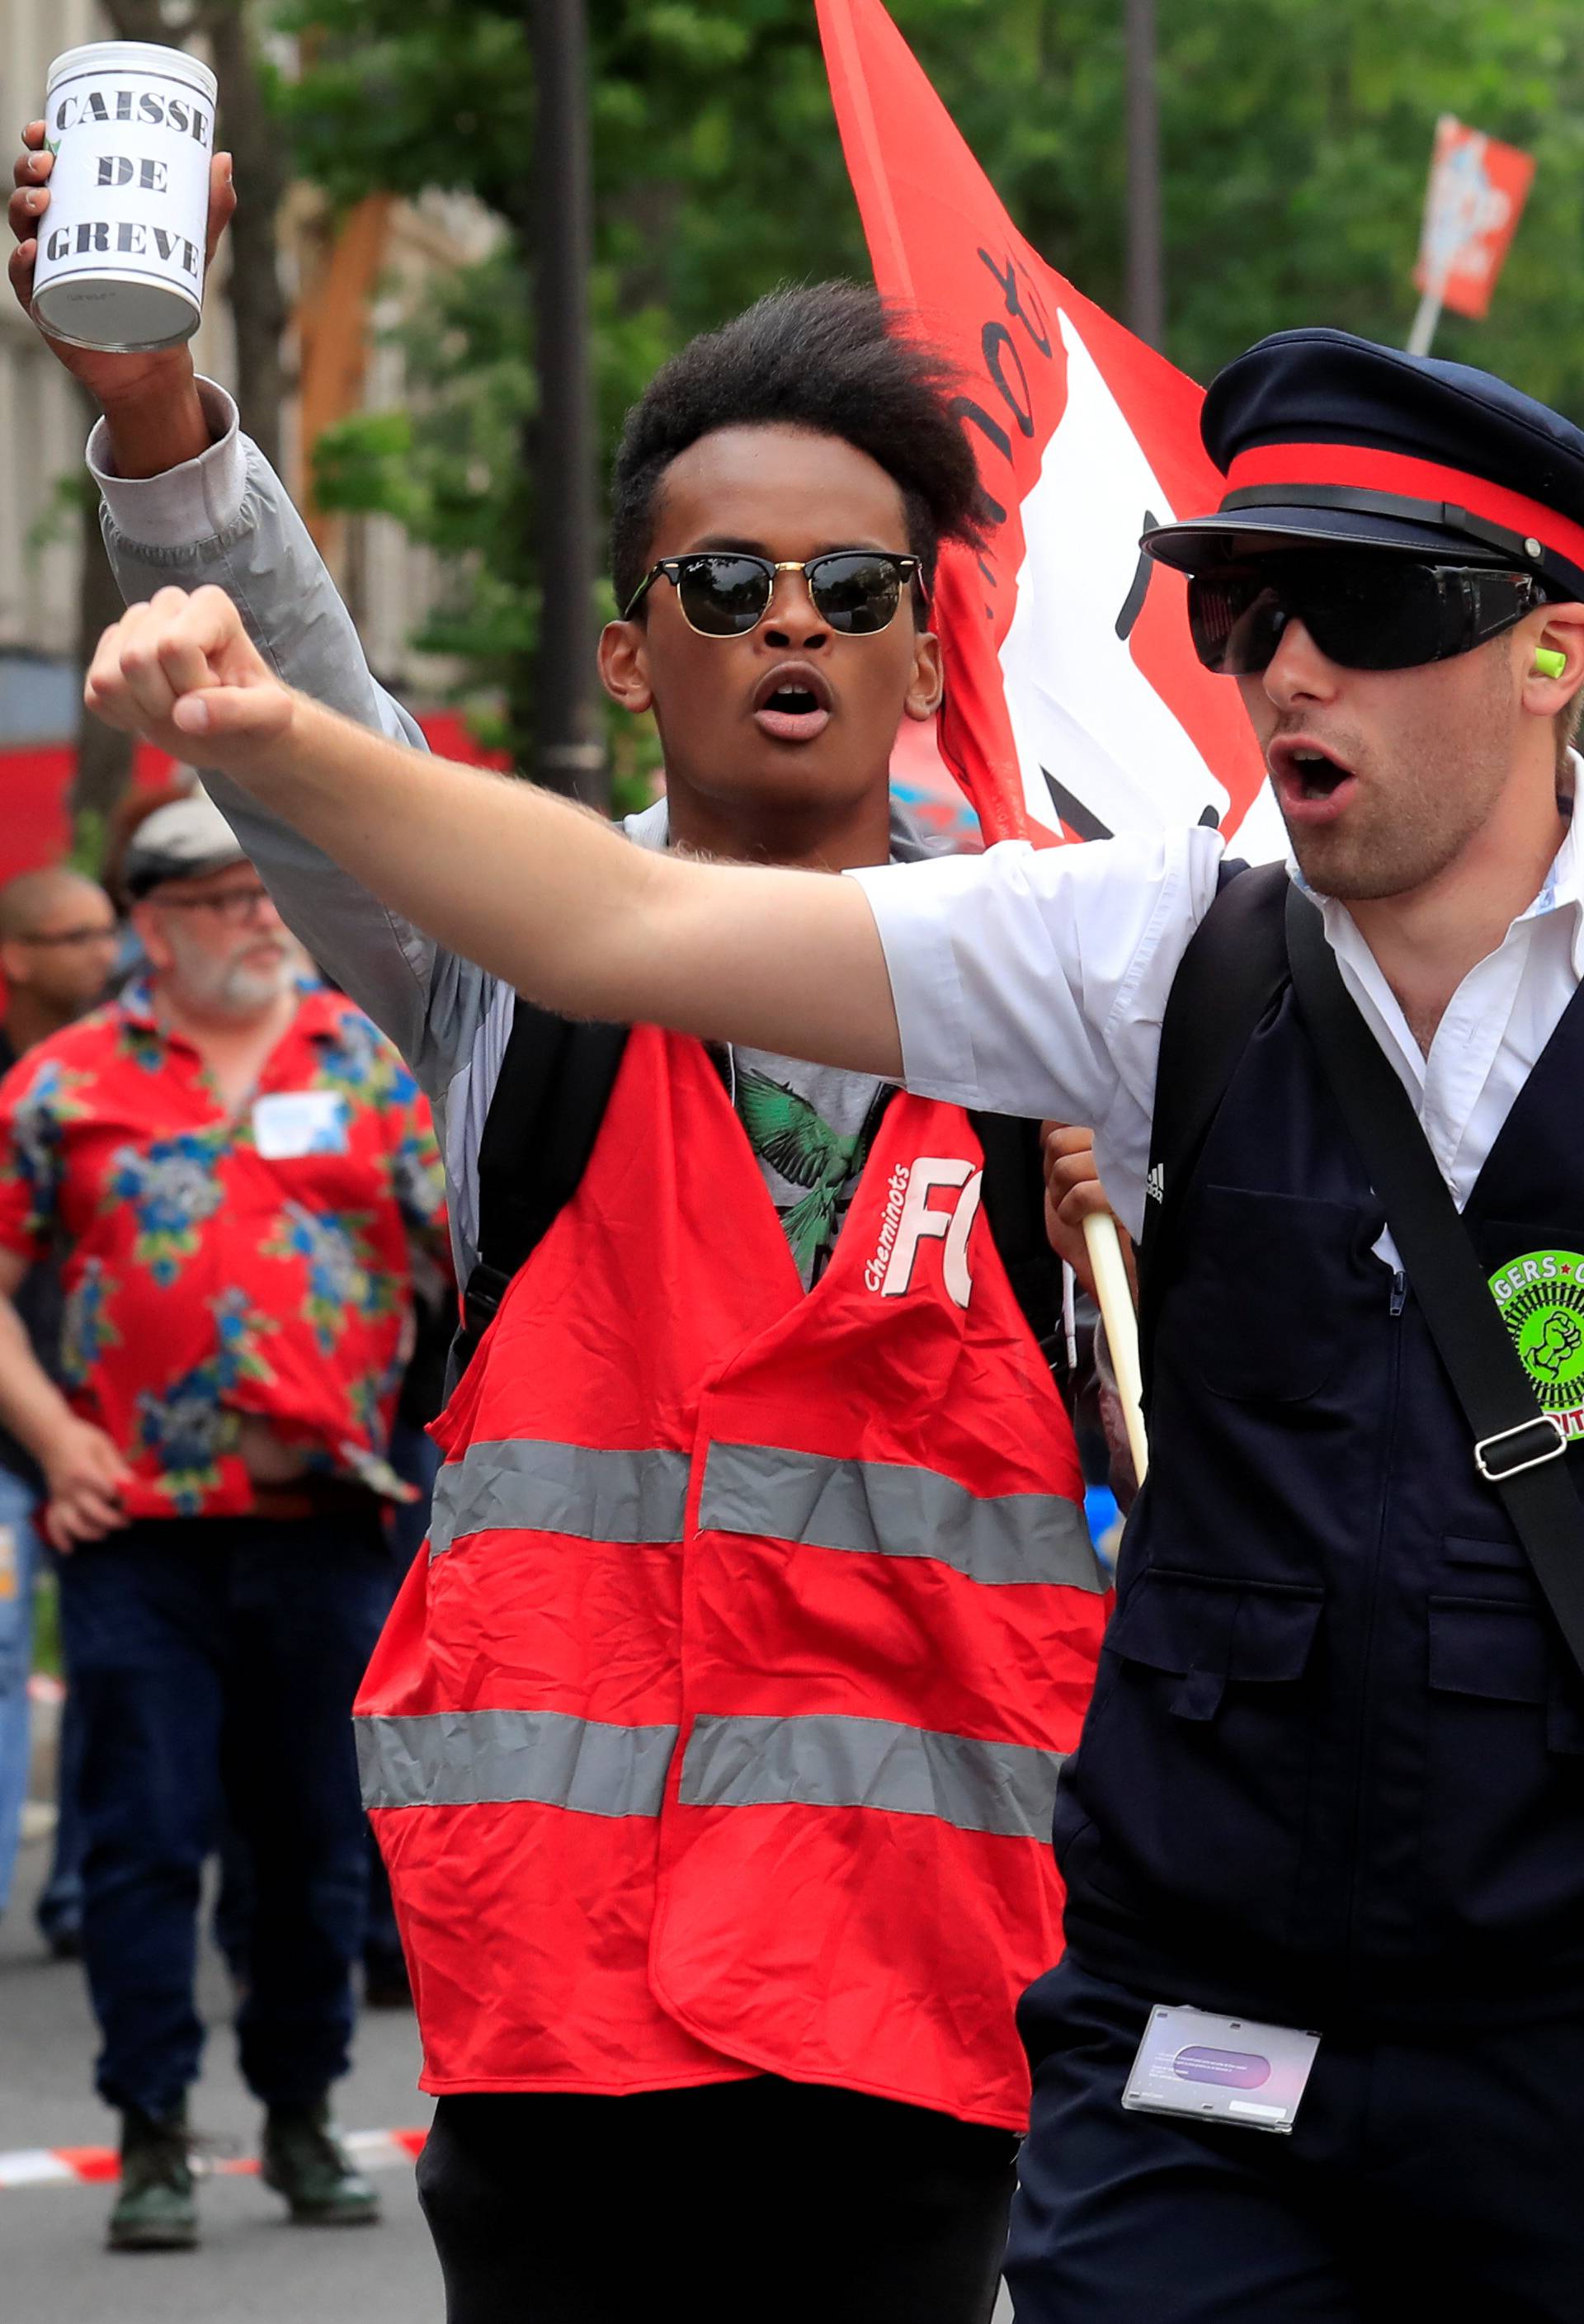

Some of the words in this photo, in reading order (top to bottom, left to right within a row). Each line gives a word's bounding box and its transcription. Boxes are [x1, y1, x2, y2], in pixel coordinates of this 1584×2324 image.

[57, 91, 209, 148] CAISSE
[95, 155, 168, 194] DE
[47, 222, 200, 279] GREVE
[864, 1162, 909, 1293] Cheminots
[1494, 1256, 1558, 1307] GERS
[1545, 1408, 1584, 1435] IT
